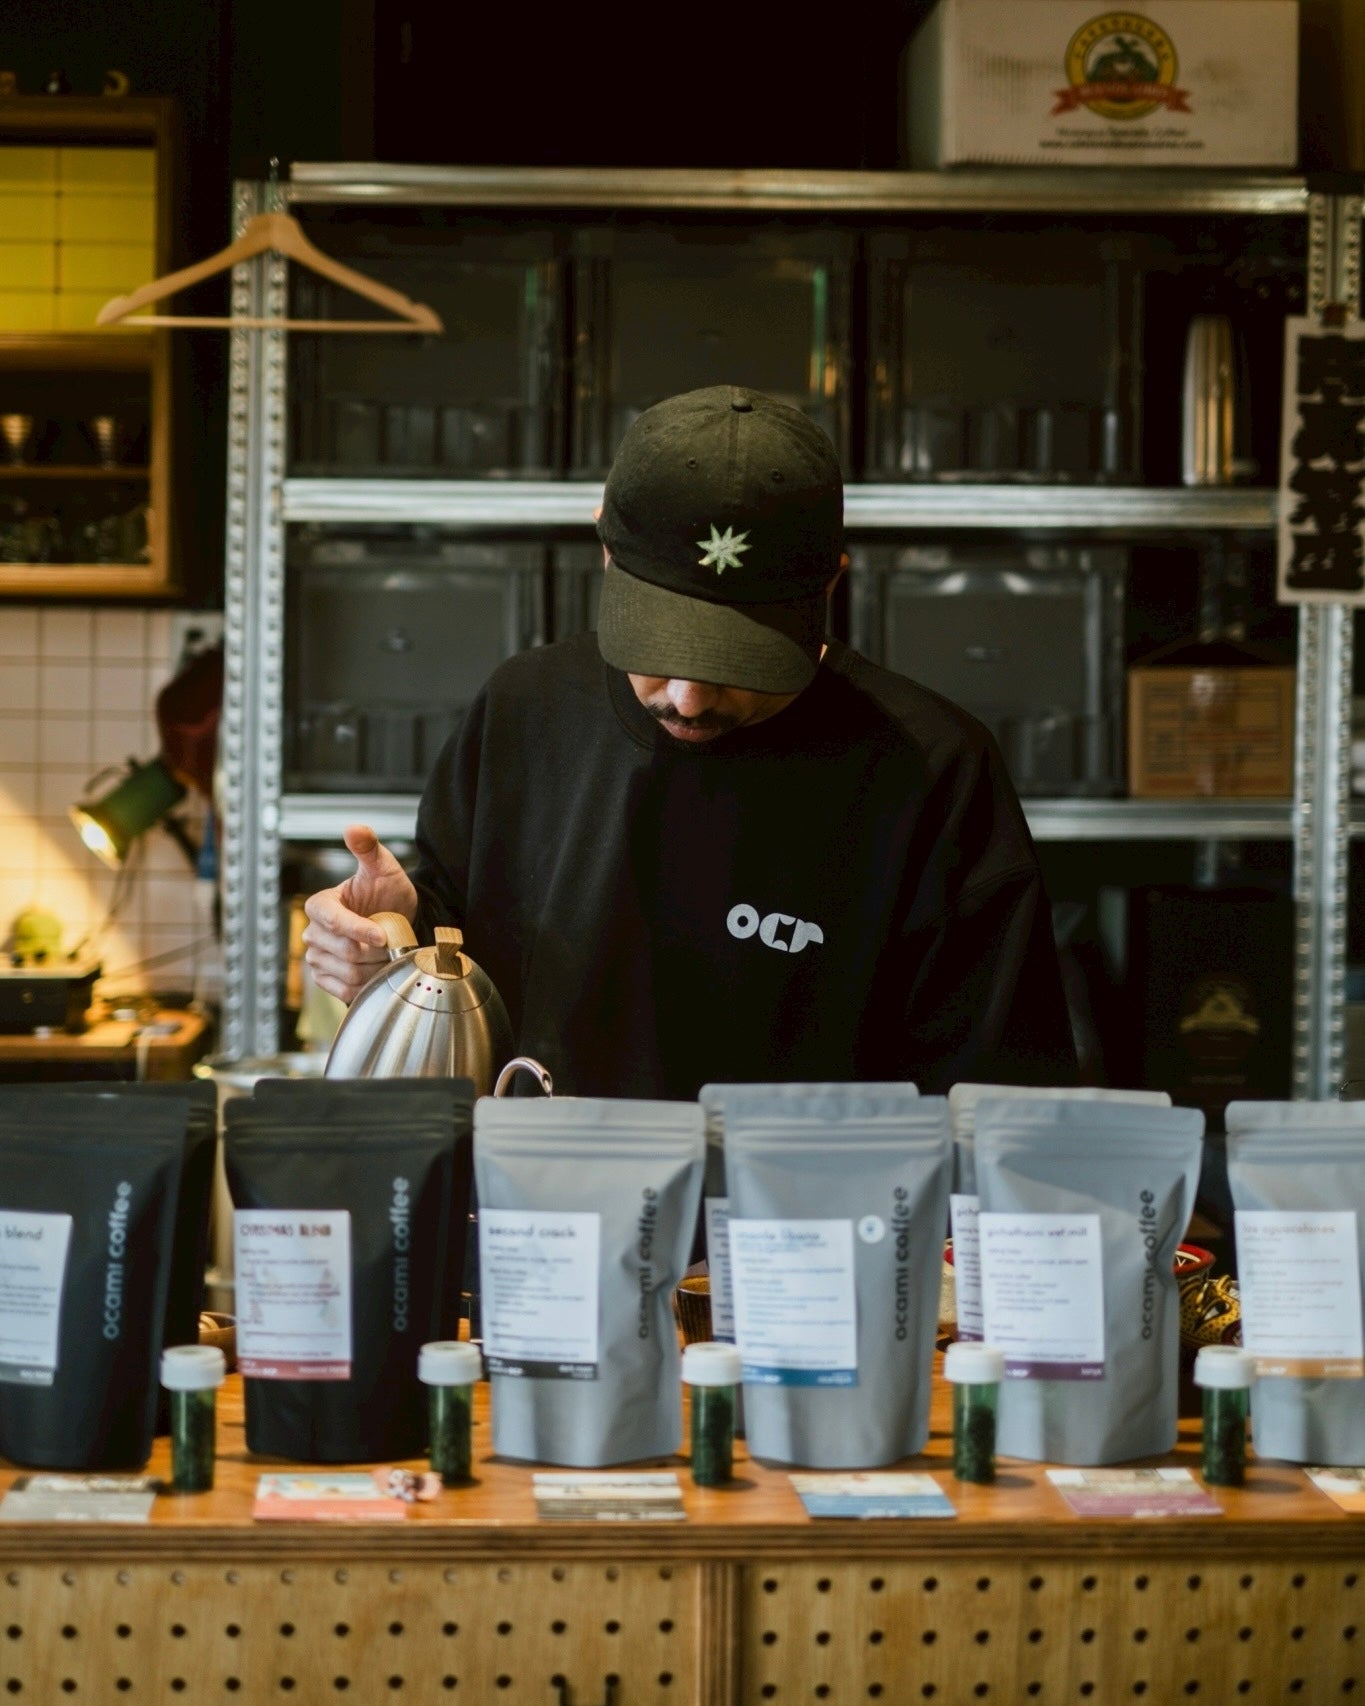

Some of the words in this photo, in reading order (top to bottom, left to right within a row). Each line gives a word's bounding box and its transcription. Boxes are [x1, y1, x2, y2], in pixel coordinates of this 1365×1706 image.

[727, 904, 823, 953] ocr
[5, 1225, 43, 1240] blend
[108, 1181, 133, 1258] coffee
[389, 1176, 410, 1250] coffee
[639, 1187, 658, 1261] coffee
[891, 1187, 909, 1262] coffee
[1139, 1189, 1157, 1262] coffee
[103, 1263, 124, 1340] ocami
[394, 1257, 409, 1332] ocami
[638, 1267, 652, 1339] ocami
[895, 1268, 909, 1341] ocami
